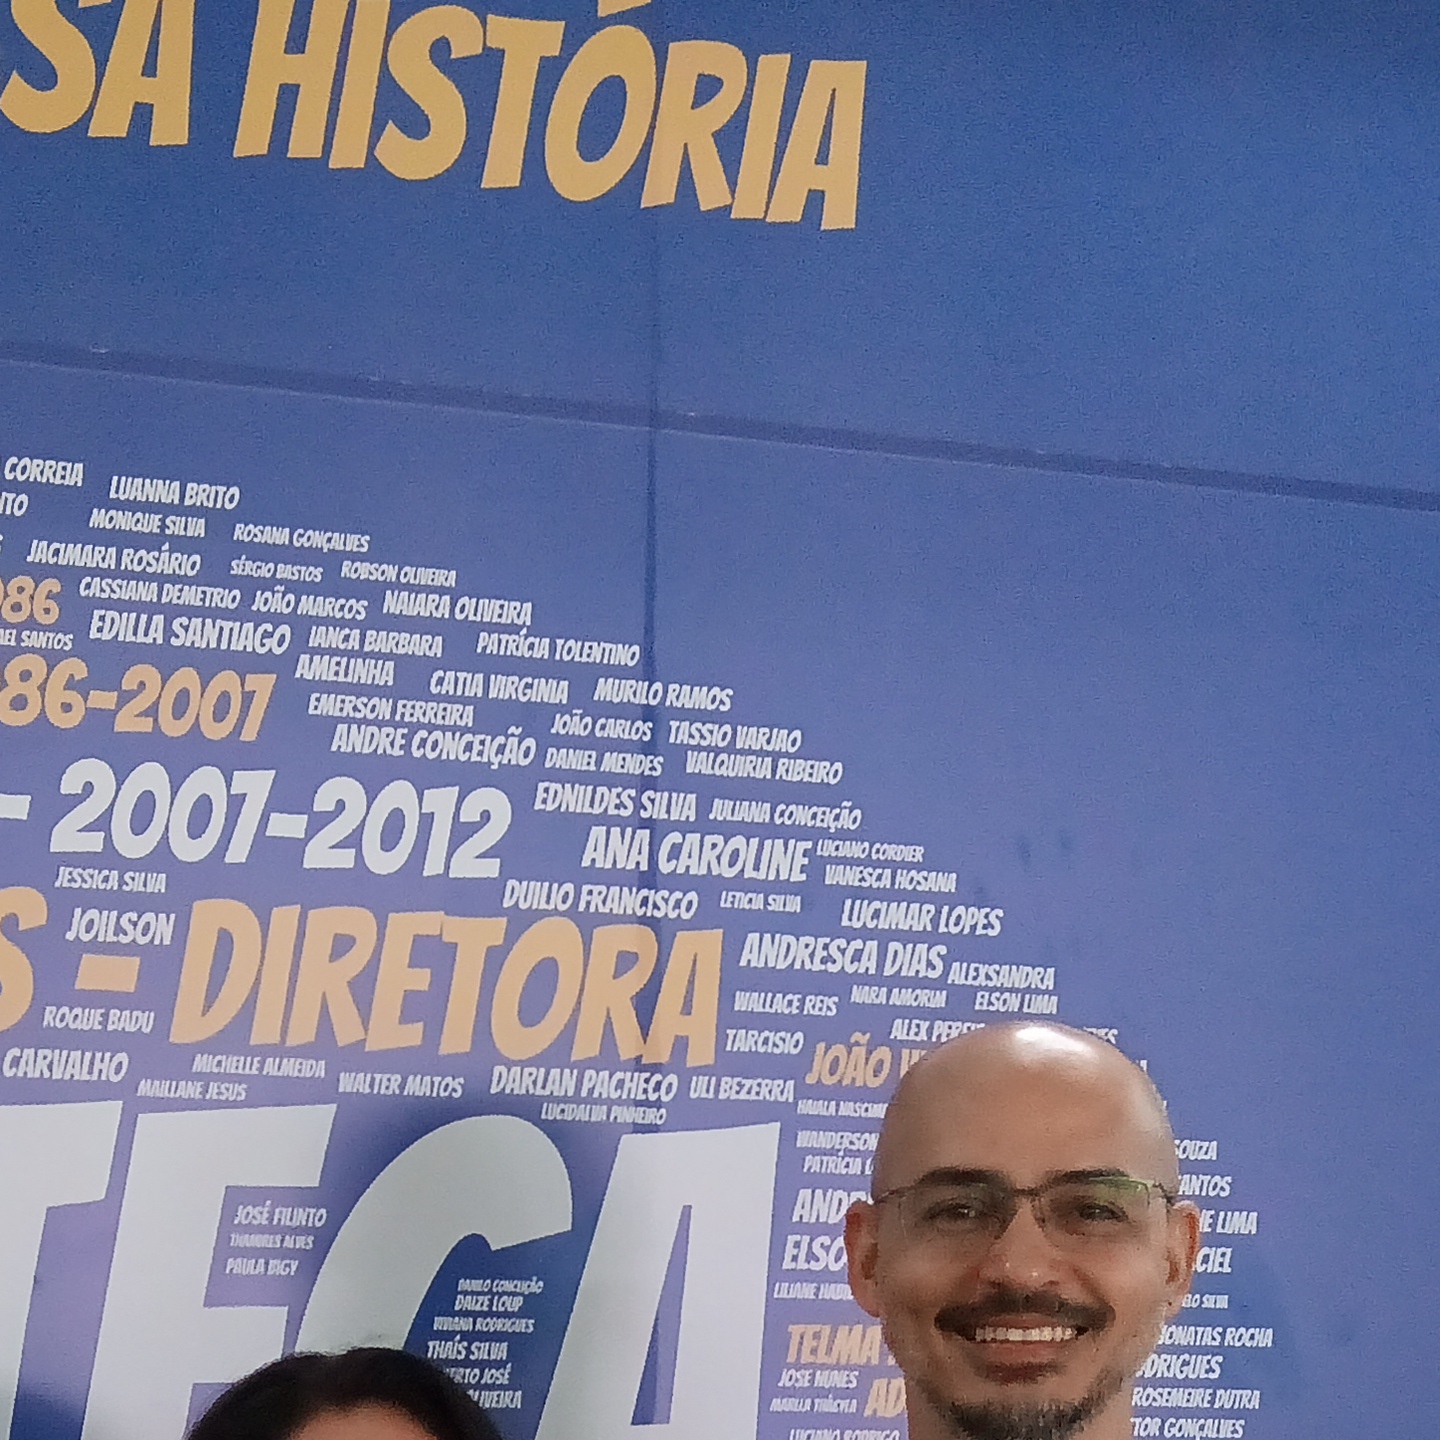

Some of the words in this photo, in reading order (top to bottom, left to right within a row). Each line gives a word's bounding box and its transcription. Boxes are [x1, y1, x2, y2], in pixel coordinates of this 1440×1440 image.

[233, 0, 867, 230] HISTÓRIA
[477, 627, 549, 659] PATRÍCIA
[555, 639, 639, 666] TOLENTINO
[50, 755, 511, 879] 2007-2012
[582, 826, 649, 870] ANA
[659, 832, 812, 882] CAROLINE
[739, 933, 878, 974] ANDRESCA
[883, 942, 947, 978] DIAS
[169, 898, 723, 1067] DIRETORA
[726, 1029, 803, 1054] TARCISIO
[234, 1200, 271, 1225] JOSÉ
[273, 1206, 326, 1227] FILINTO
